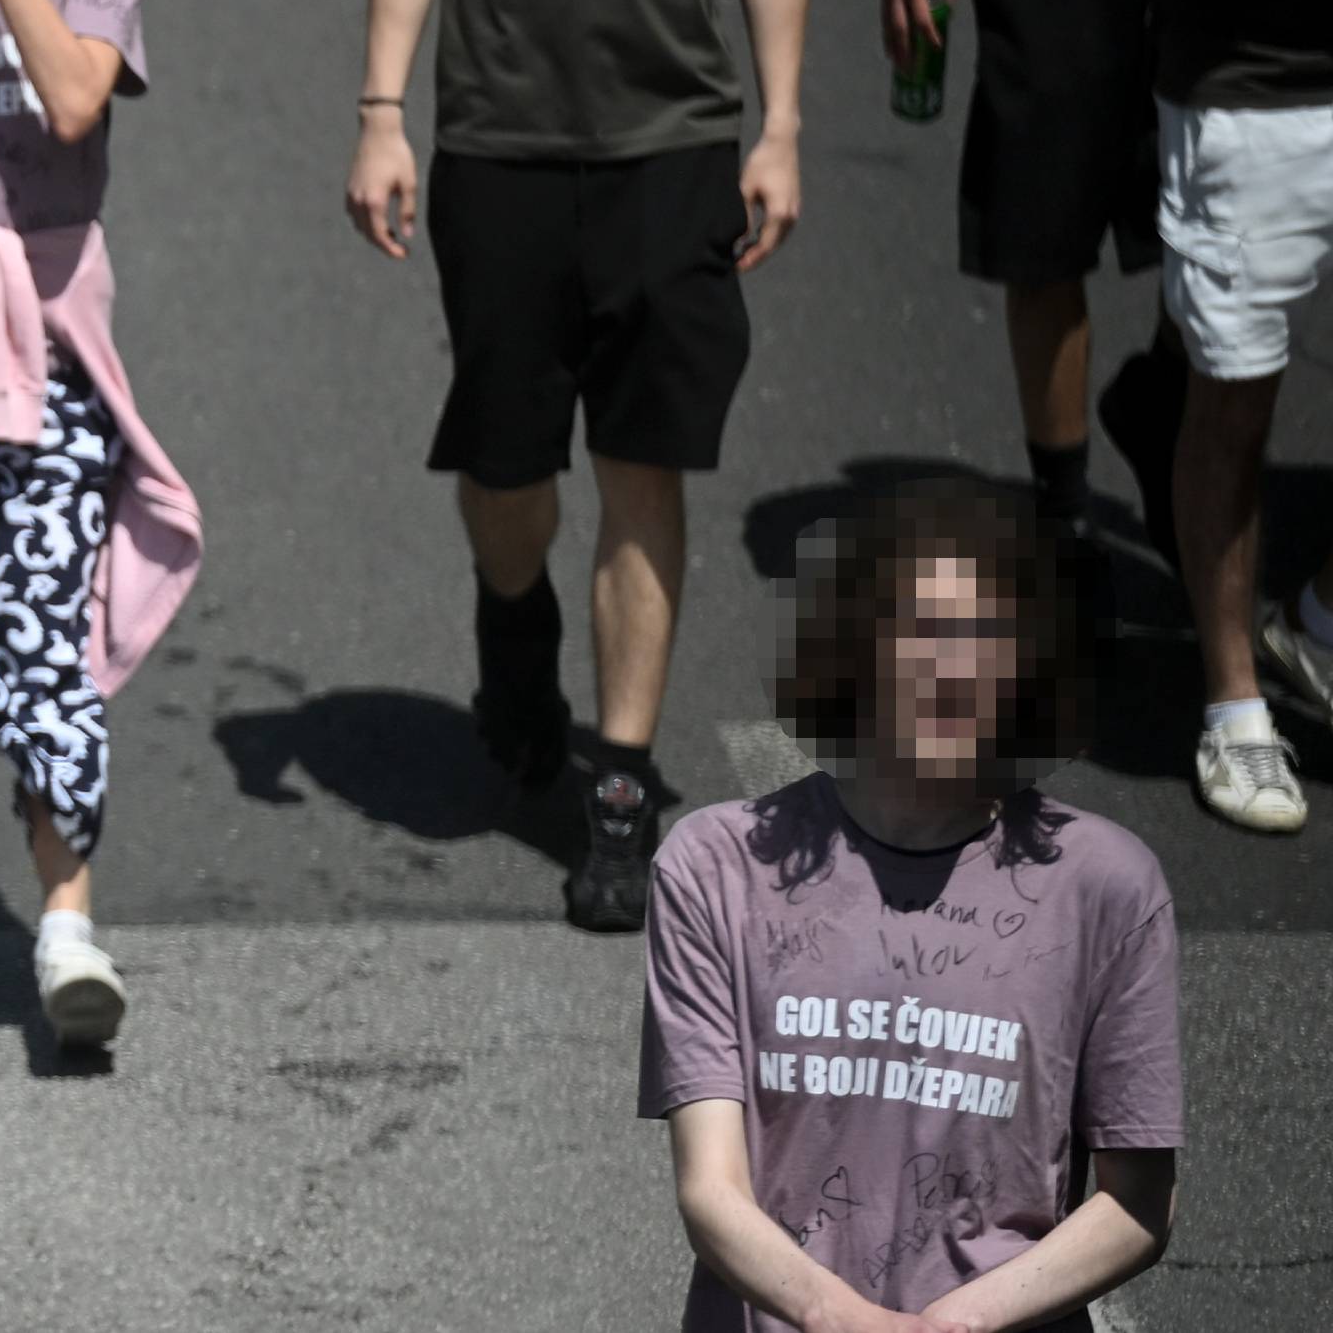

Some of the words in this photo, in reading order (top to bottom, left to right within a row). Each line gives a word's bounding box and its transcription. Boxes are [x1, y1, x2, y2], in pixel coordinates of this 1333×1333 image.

[775, 995, 842, 1038] GOL
[846, 999, 891, 1041] SE
[894, 995, 1023, 1061] ČOVJEK
[759, 1051, 797, 1093] NE
[803, 1054, 880, 1097] BOJI
[883, 1056, 1021, 1119] DŽEPARA
